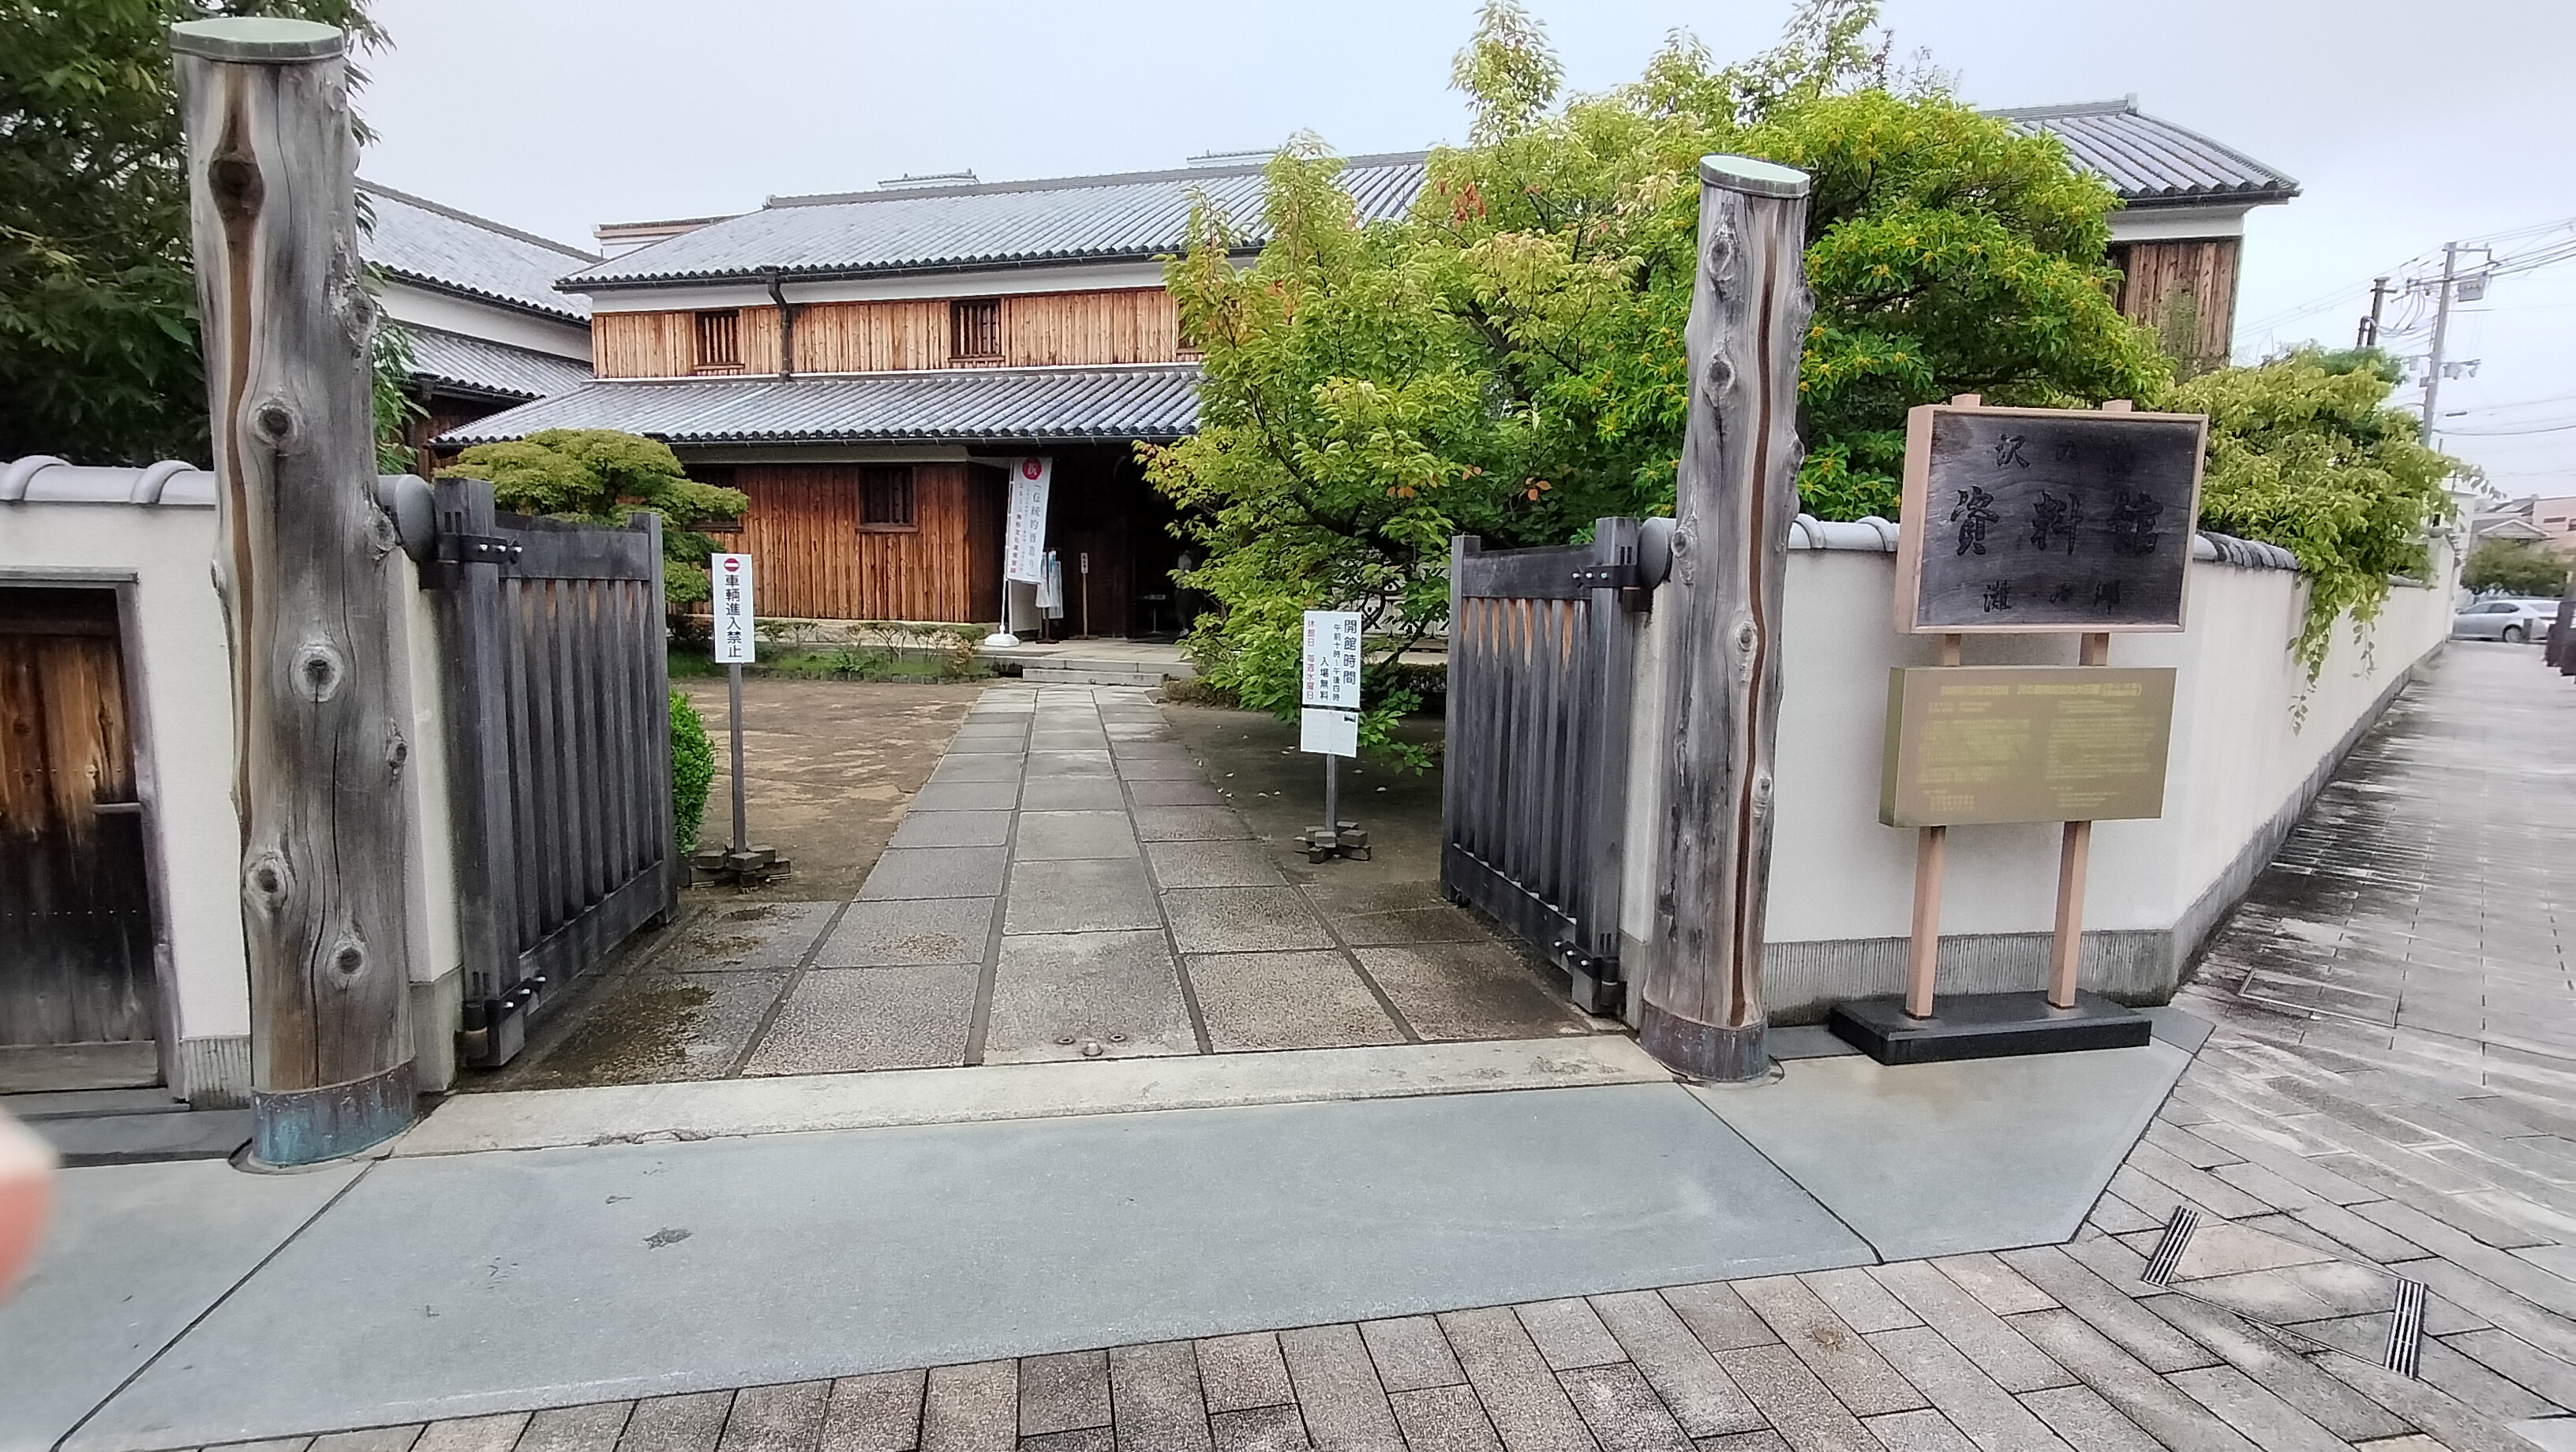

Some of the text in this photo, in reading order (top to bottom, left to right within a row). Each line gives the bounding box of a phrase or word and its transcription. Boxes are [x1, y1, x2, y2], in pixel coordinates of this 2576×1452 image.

[1950, 485, 2164, 556] 資料館
[1306, 654, 1315, 700] 毎週水曜日
[1320, 657, 1329, 701] 入場無料
[1343, 619, 1357, 685] 開館時間
